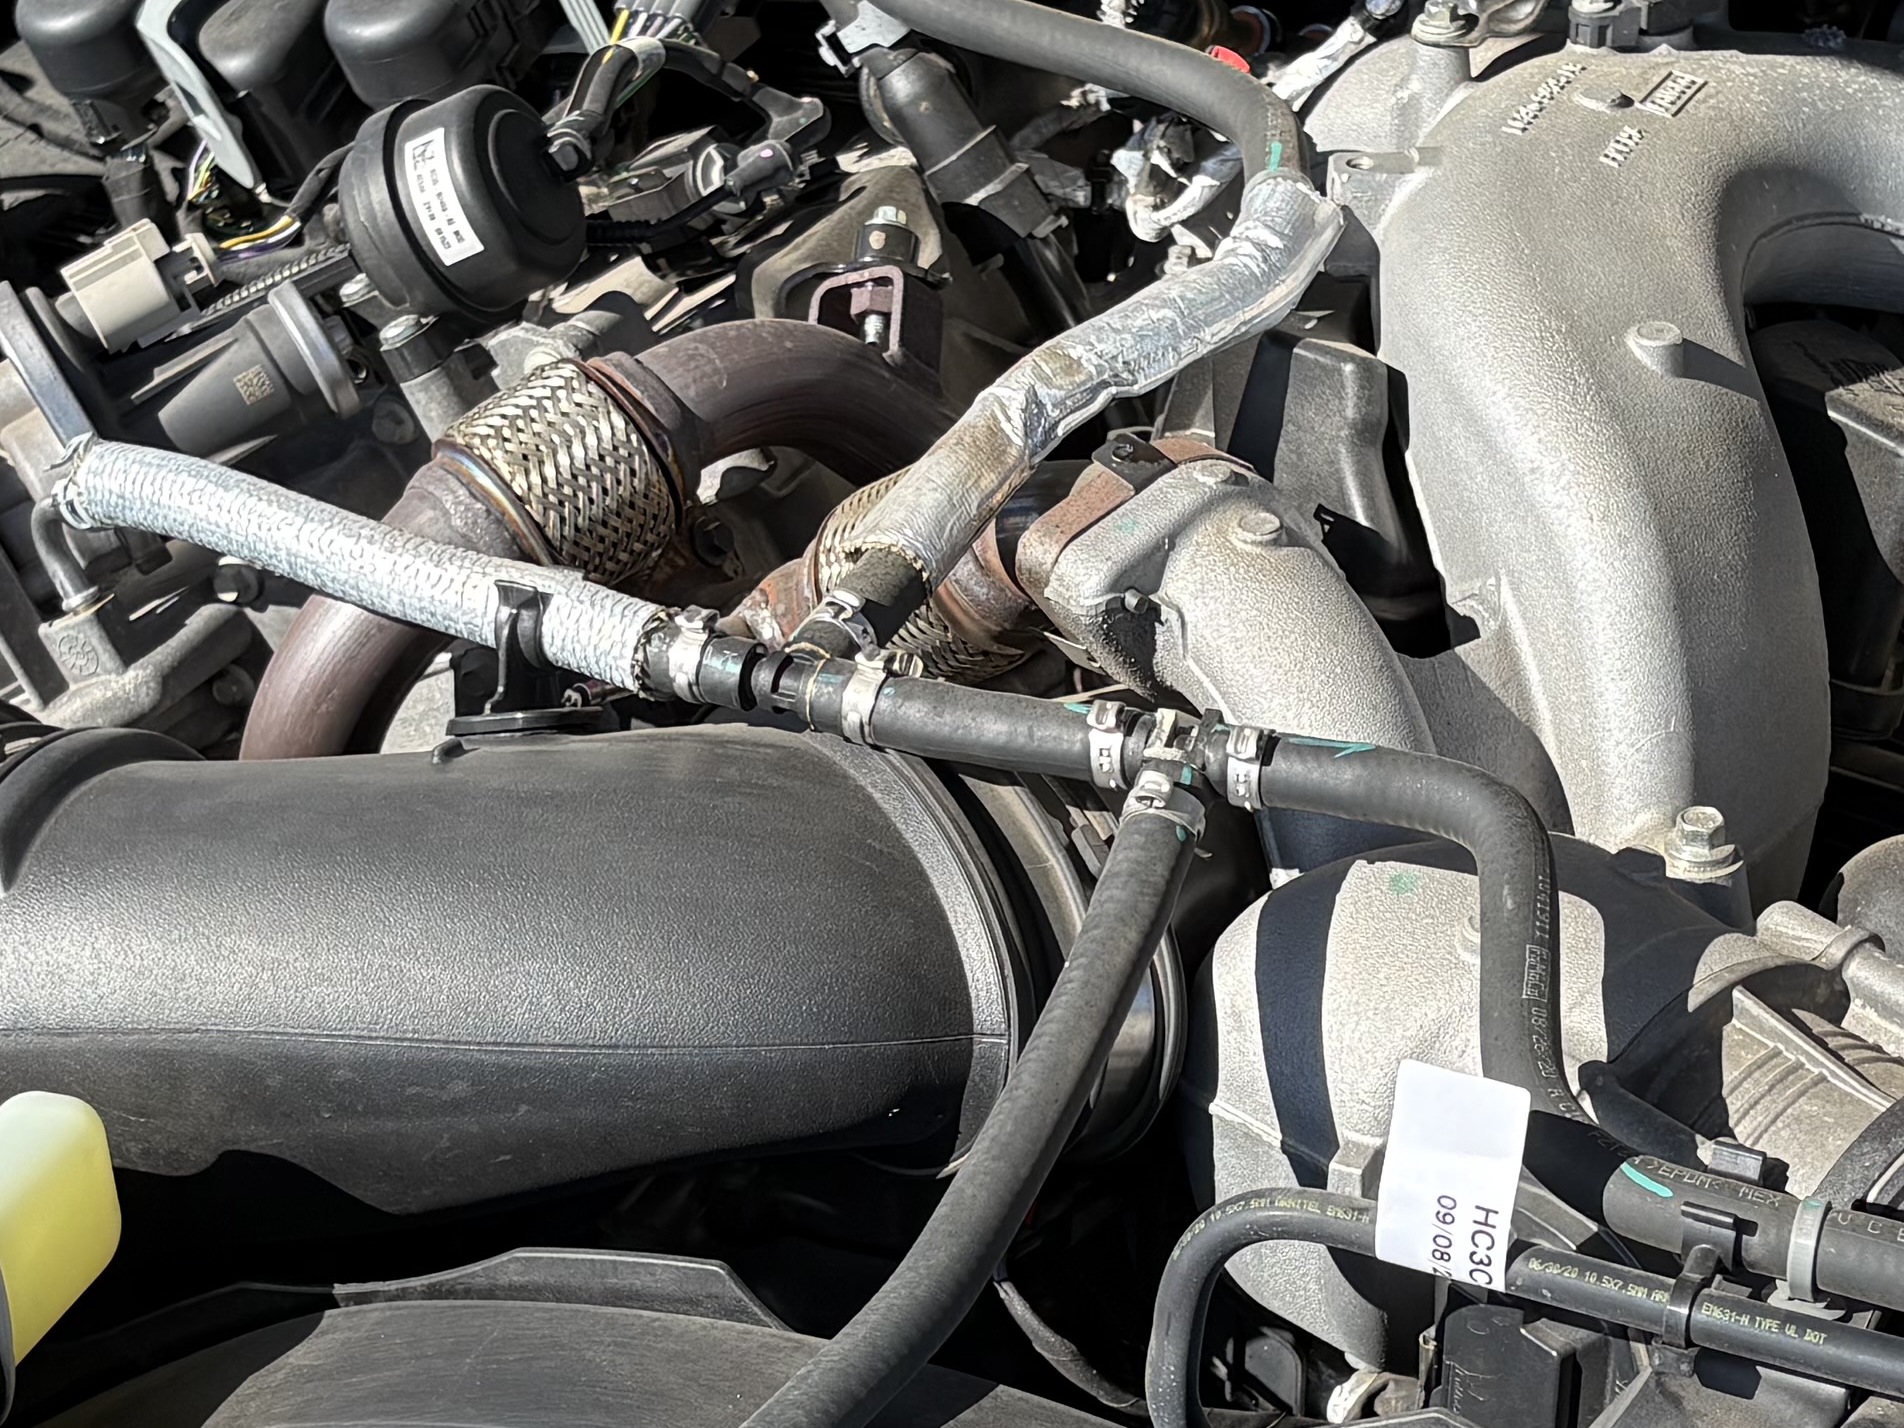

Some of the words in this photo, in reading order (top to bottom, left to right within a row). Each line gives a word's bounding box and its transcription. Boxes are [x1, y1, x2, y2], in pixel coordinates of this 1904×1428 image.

[1738, 1185, 1781, 1208] MEX
[1753, 1315, 1781, 1333] TYPE
[1802, 1328, 1828, 1346] DOT
